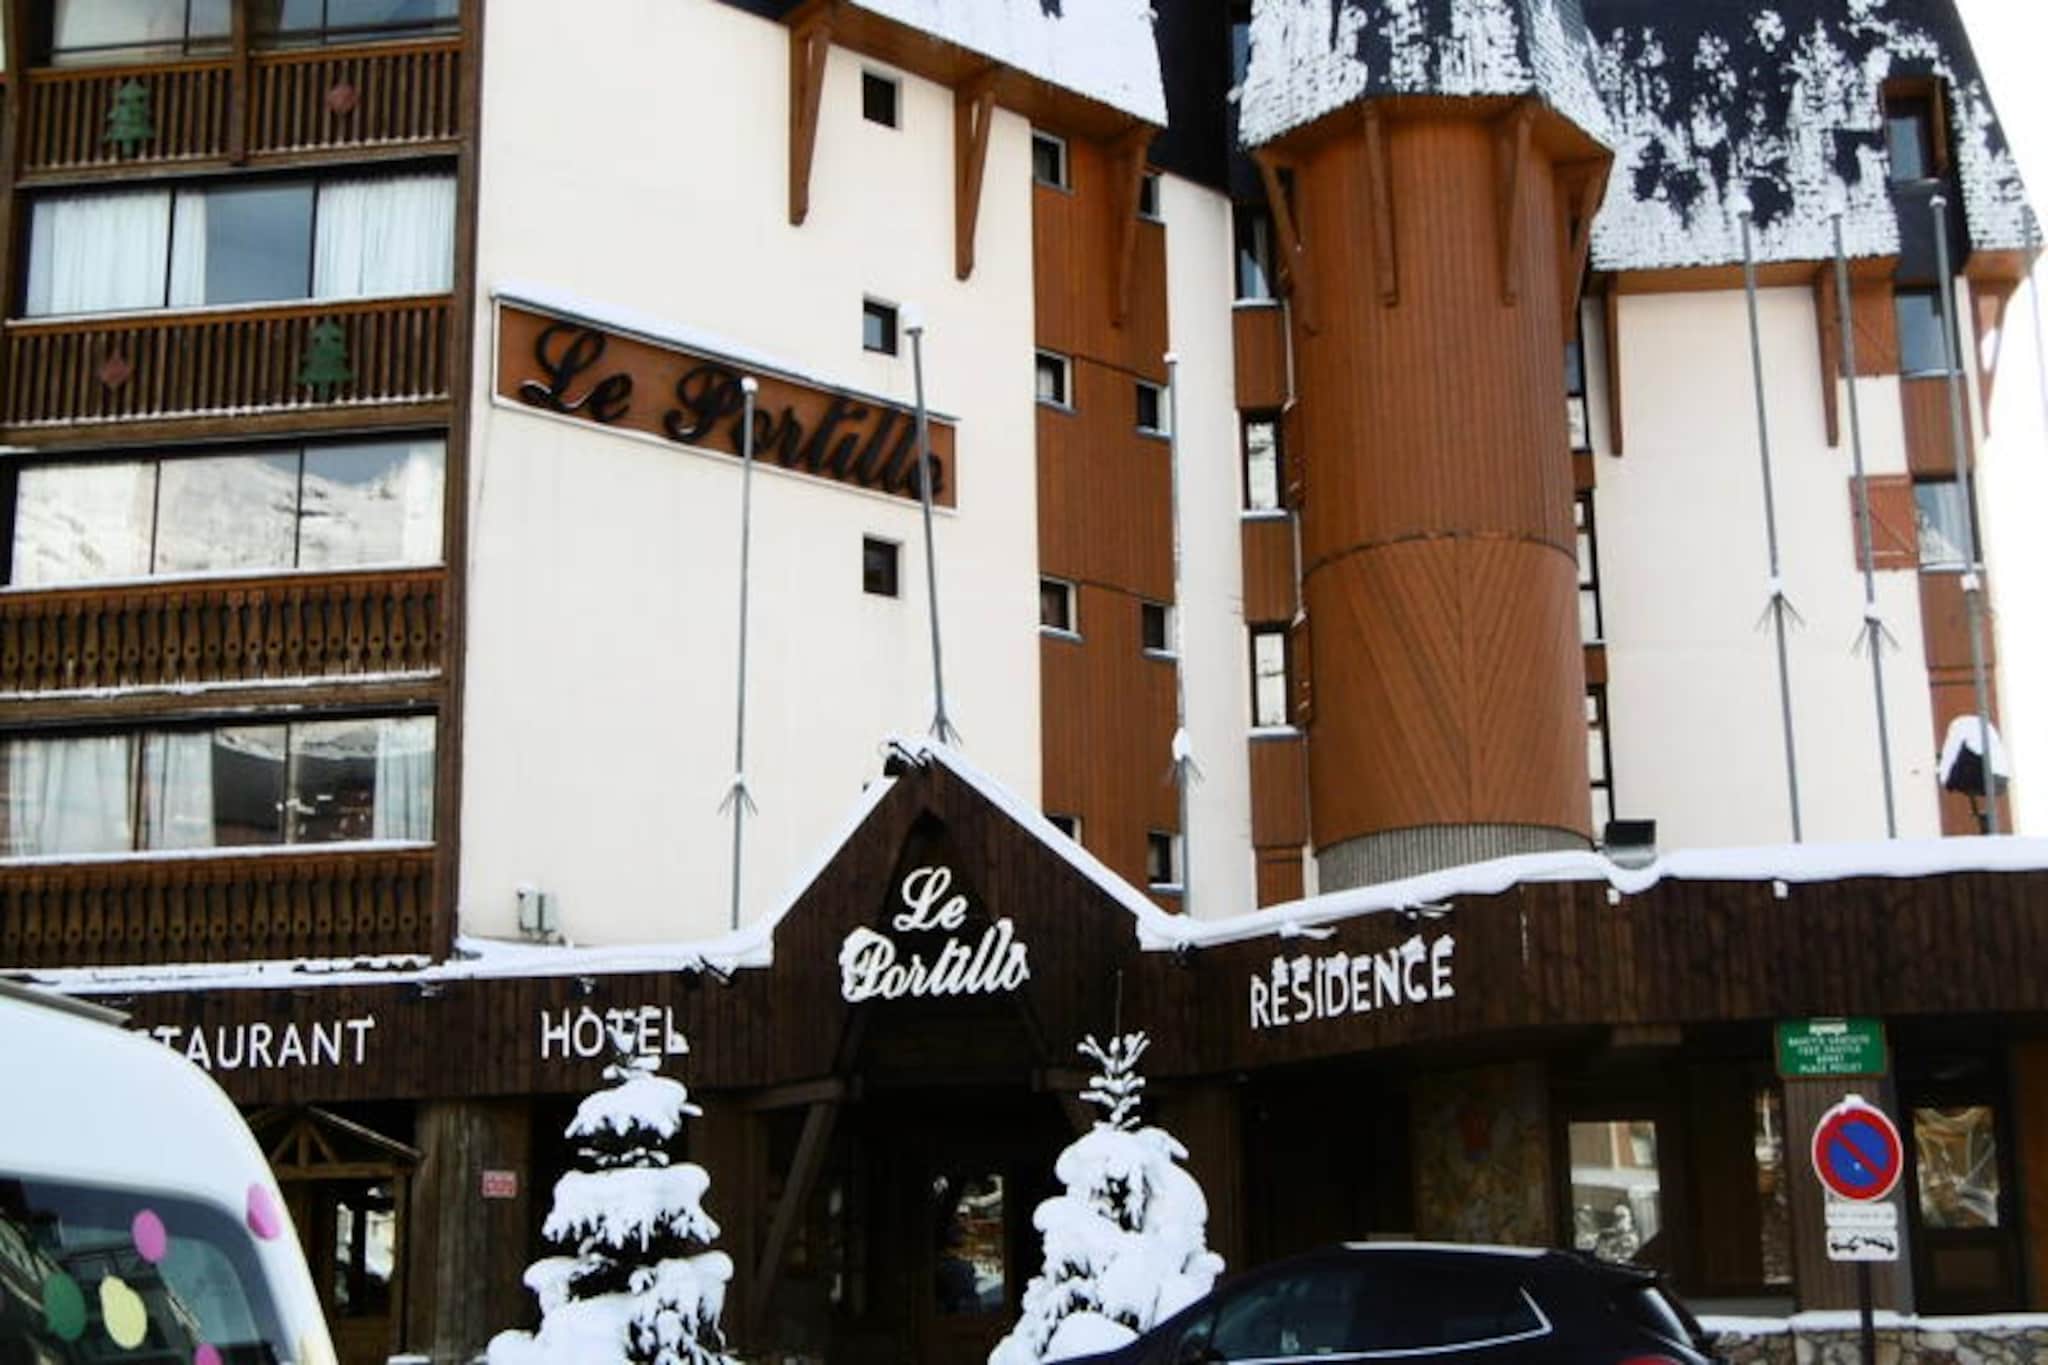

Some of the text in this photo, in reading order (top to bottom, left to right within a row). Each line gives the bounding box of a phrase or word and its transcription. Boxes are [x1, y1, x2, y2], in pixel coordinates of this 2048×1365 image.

[519, 323, 944, 502] Le Portillo
[892, 866, 968, 931] Le
[838, 917, 1031, 1003] Portillo
[141, 1015, 376, 1071] TAURANT
